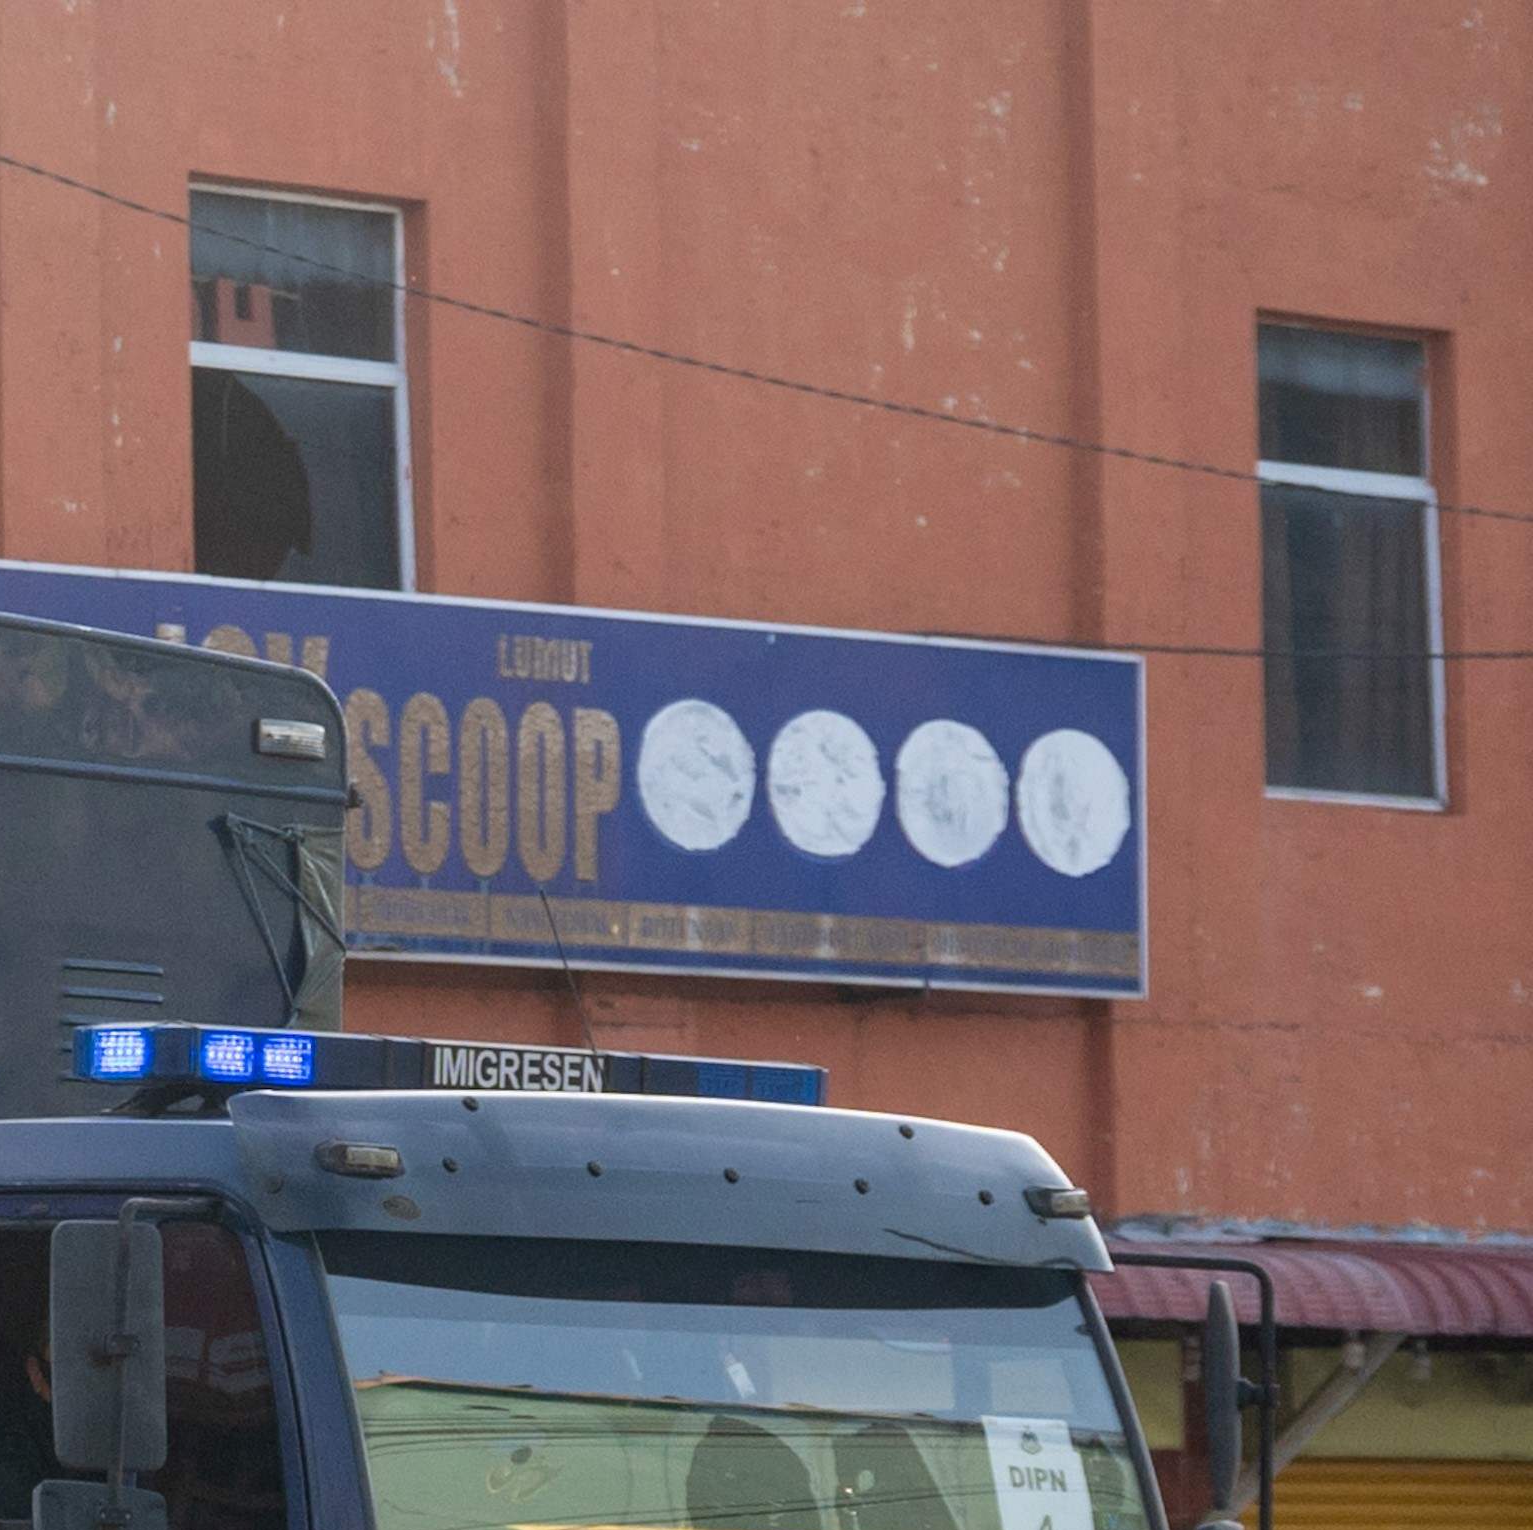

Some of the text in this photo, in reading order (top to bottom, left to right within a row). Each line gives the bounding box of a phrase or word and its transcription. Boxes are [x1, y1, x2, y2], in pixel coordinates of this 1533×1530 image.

[345, 688, 621, 884] SCOOP
[434, 1046, 604, 1093] IMIGRESEN
[1008, 1465, 1068, 1493] DIPN
